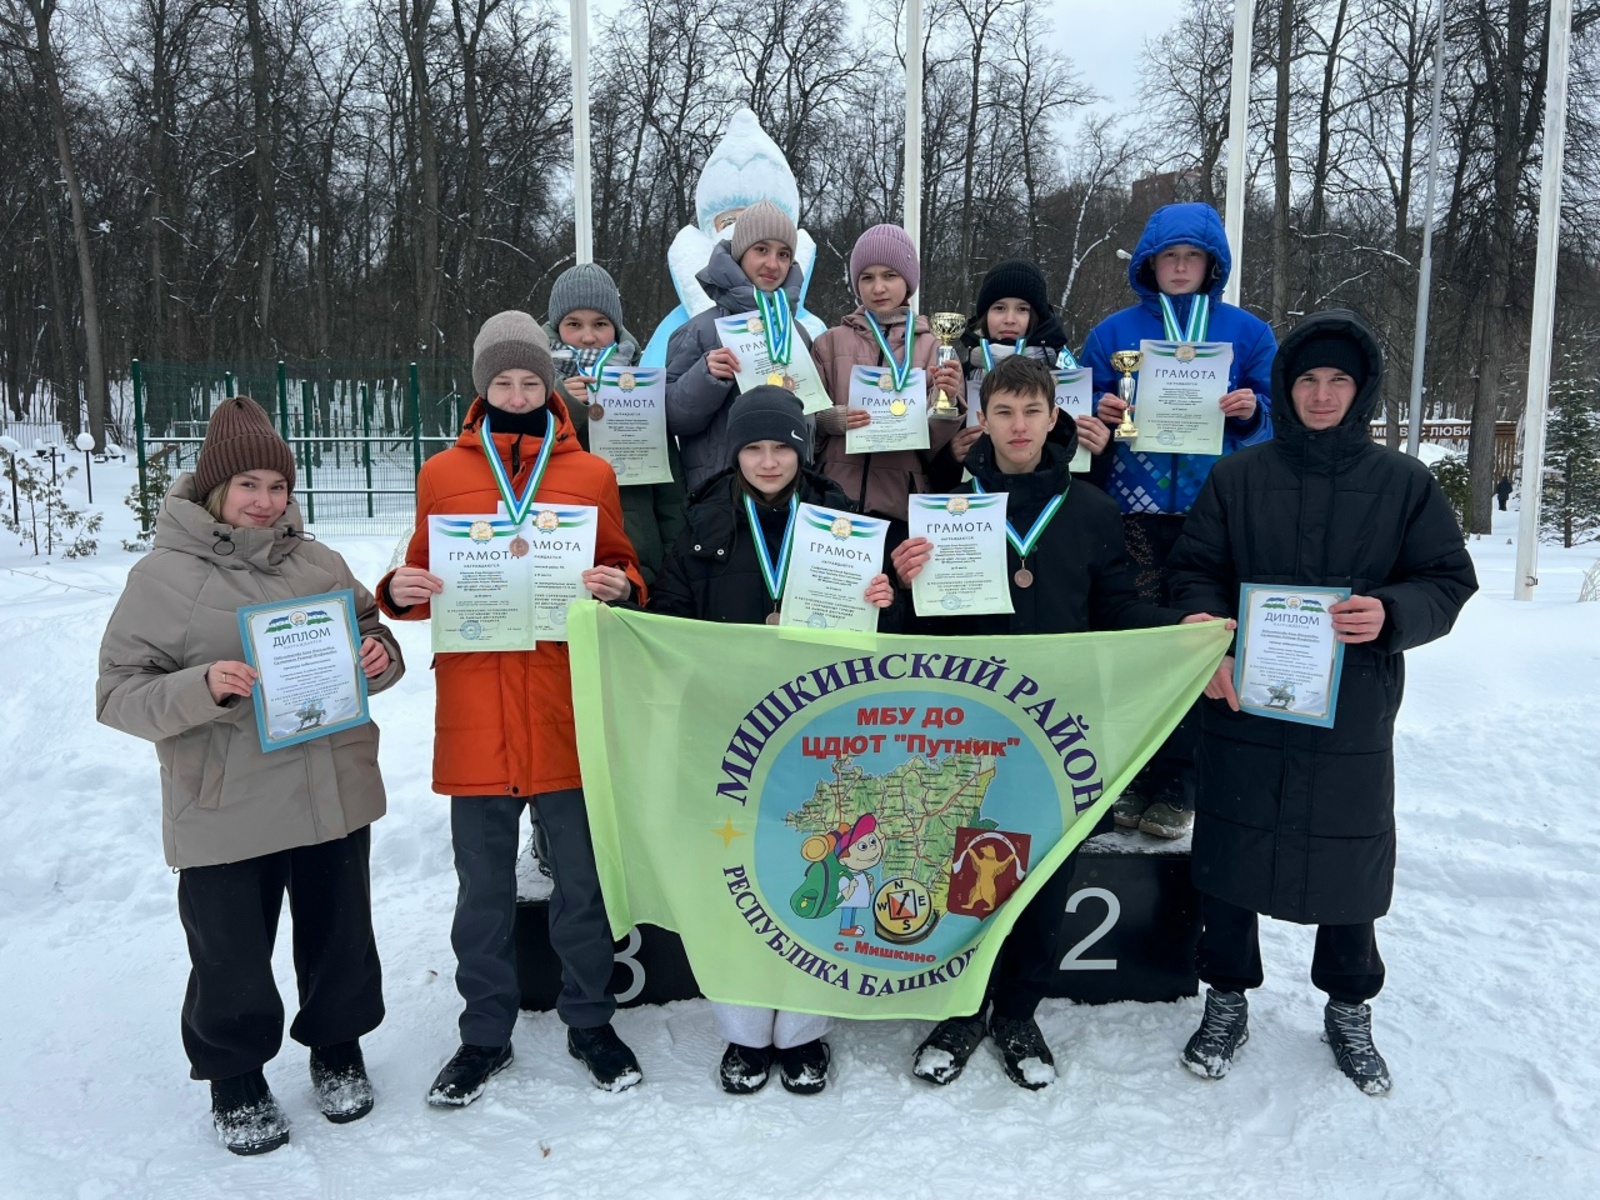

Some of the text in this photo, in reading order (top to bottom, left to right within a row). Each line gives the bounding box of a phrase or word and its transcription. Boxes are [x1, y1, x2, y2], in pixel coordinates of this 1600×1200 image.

[740, 340, 767, 353] ГРАМ
[1155, 369, 1216, 379] ГРАМОТА
[602, 399, 655, 408] ГРАМОТА
[1429, 426, 1471, 437] ЛЮБИ
[926, 521, 993, 534] ГРАМОТА
[810, 542, 873, 563] ГРАМОТА
[1264, 612, 1320, 626] ДИПЛОМ
[273, 627, 331, 648] ДИПЛОМ
[857, 707, 965, 728] МБУ ДО
[716, 653, 1104, 816] МИШКИНСКИЙ РАЙОН
[802, 734, 1020, 760] ЦДЮТ "Путник"
[894, 880, 904, 890] N
[877, 902, 888, 911] W
[918, 895, 927, 907] E
[723, 864, 850, 991] РЕСПУБЛИКА
[902, 920, 911, 931] S
[1059, 887, 1121, 971] 2
[855, 940, 937, 963] Мишкино
